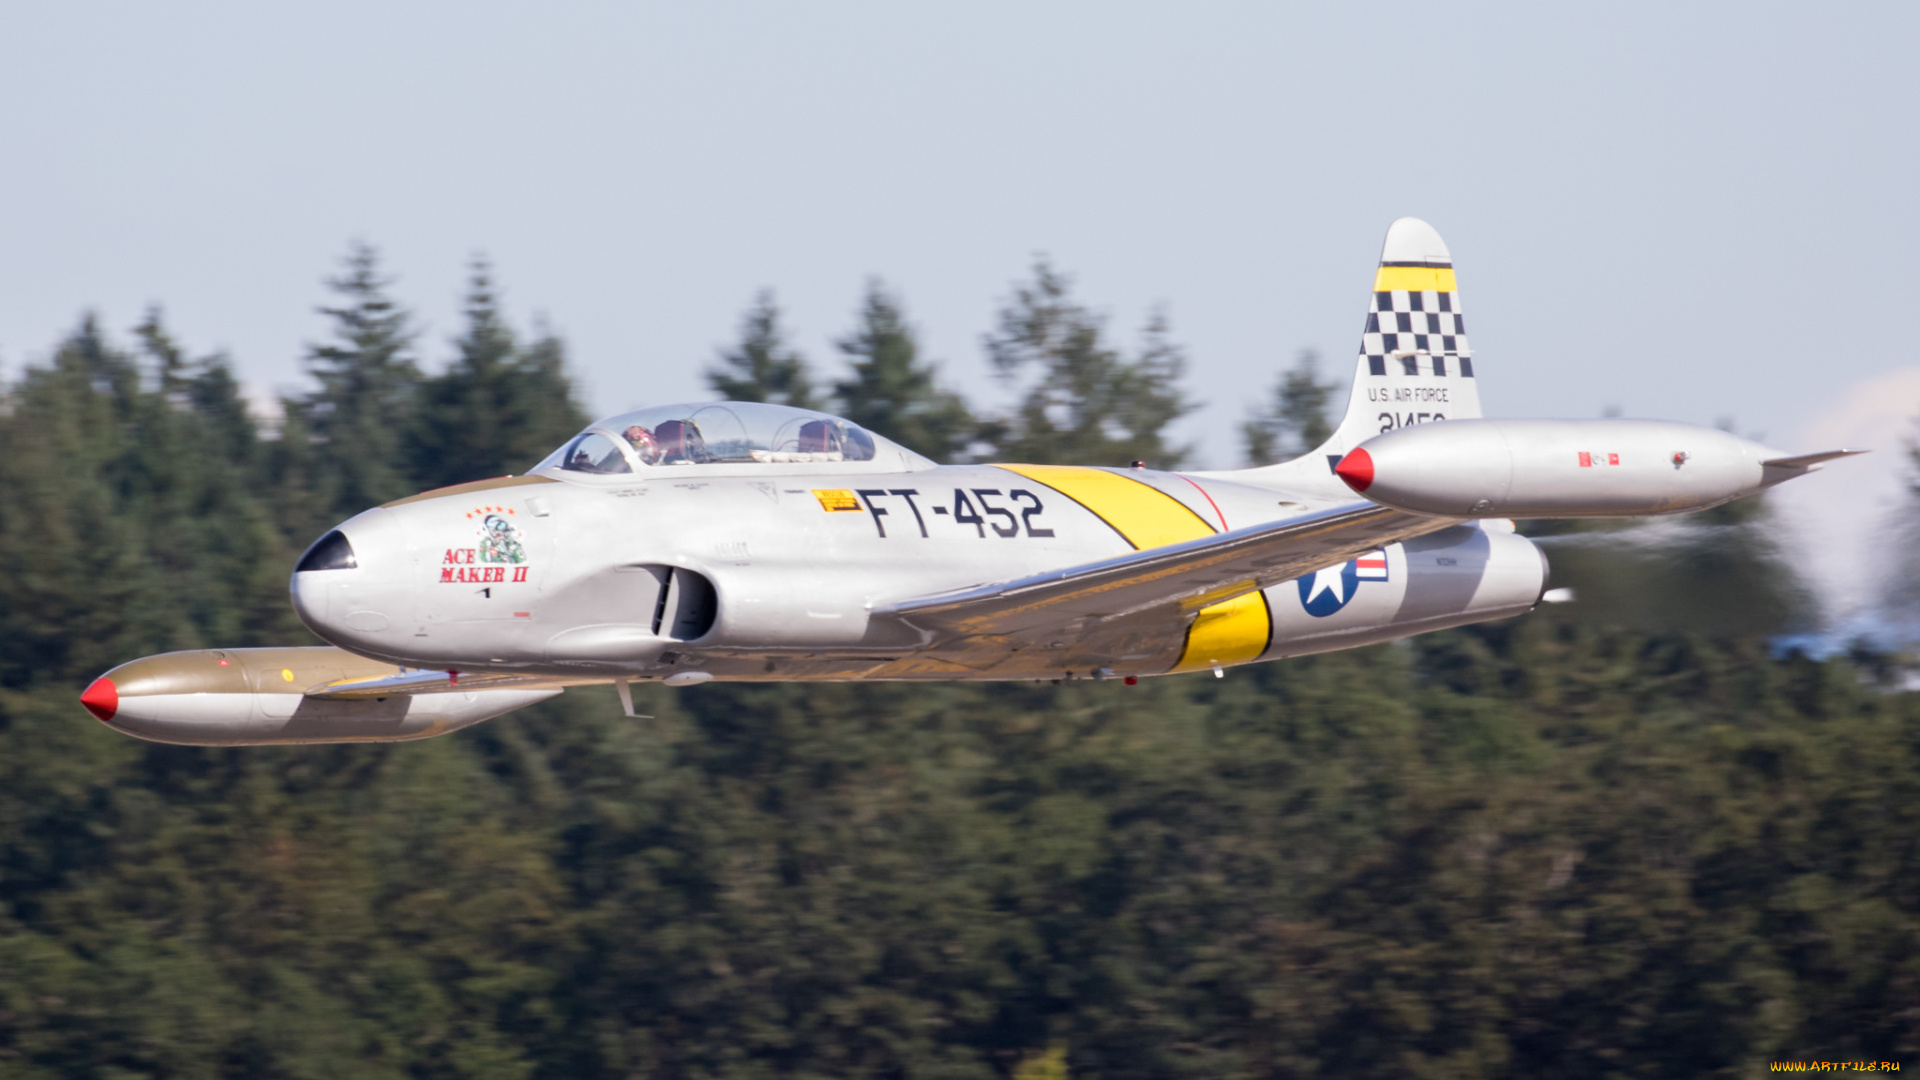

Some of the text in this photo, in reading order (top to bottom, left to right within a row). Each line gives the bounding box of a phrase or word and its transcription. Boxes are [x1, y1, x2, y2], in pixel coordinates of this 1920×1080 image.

[1367, 388, 1449, 402] U.S. AIR FORCE
[1378, 412, 1446, 434] 214
[855, 488, 1055, 538] FT-452
[442, 548, 476, 564] ACE
[439, 566, 529, 583] MAKER II
